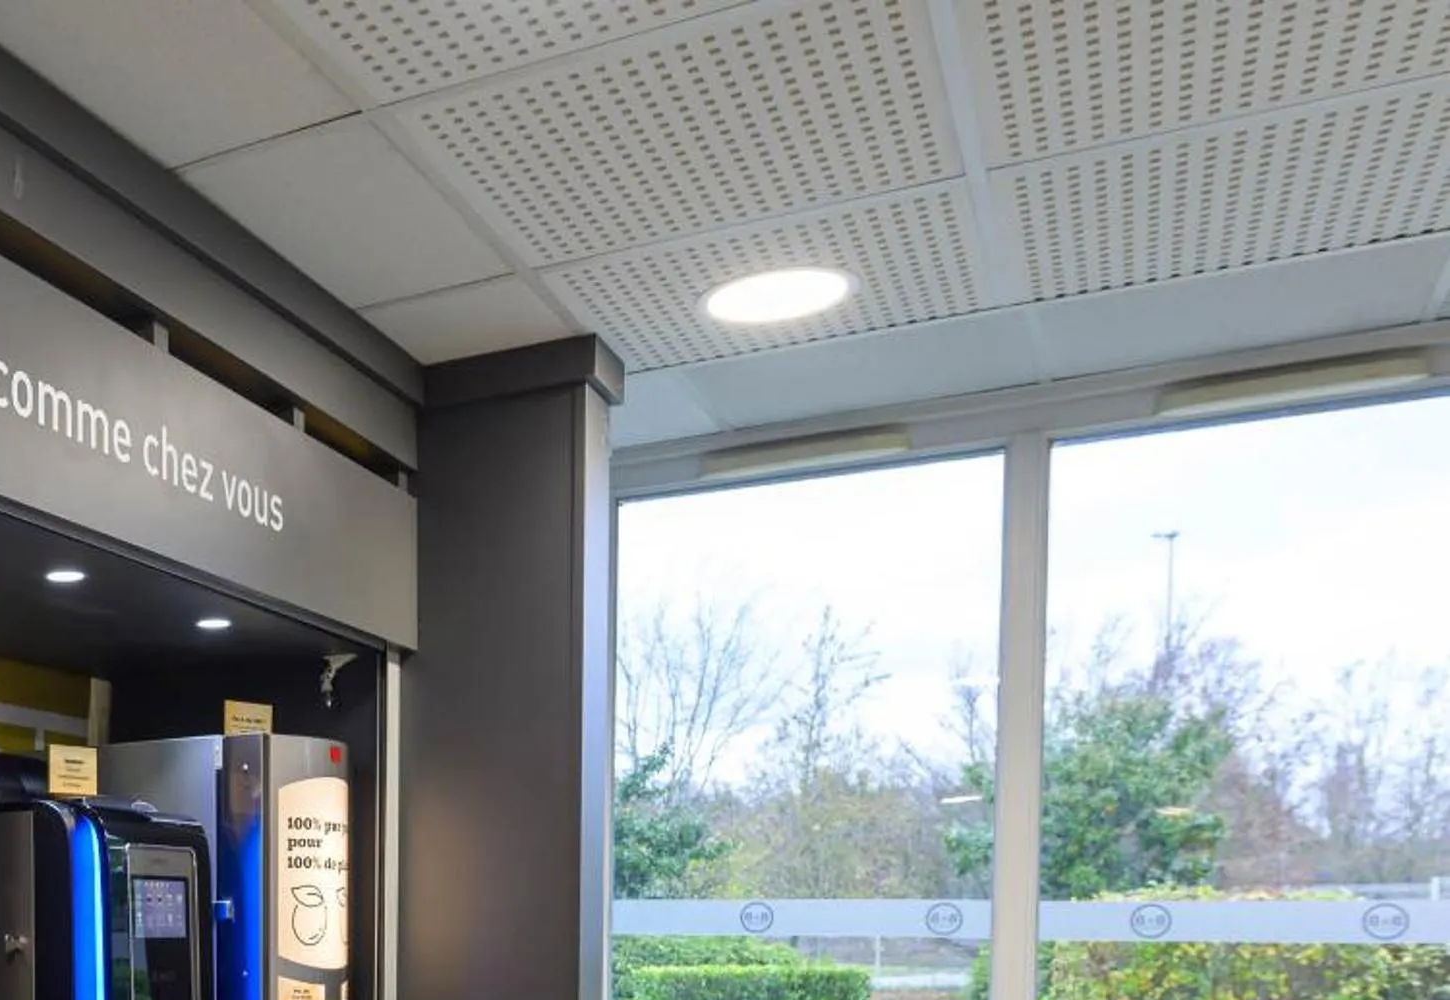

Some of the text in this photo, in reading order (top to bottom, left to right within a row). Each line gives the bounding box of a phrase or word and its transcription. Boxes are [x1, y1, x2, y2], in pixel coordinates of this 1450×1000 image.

[143, 425, 214, 501] chez
[221, 469, 284, 532] vous
[287, 816, 322, 831] 100%
[287, 837, 323, 852] pour
[287, 855, 322, 869] 100%
